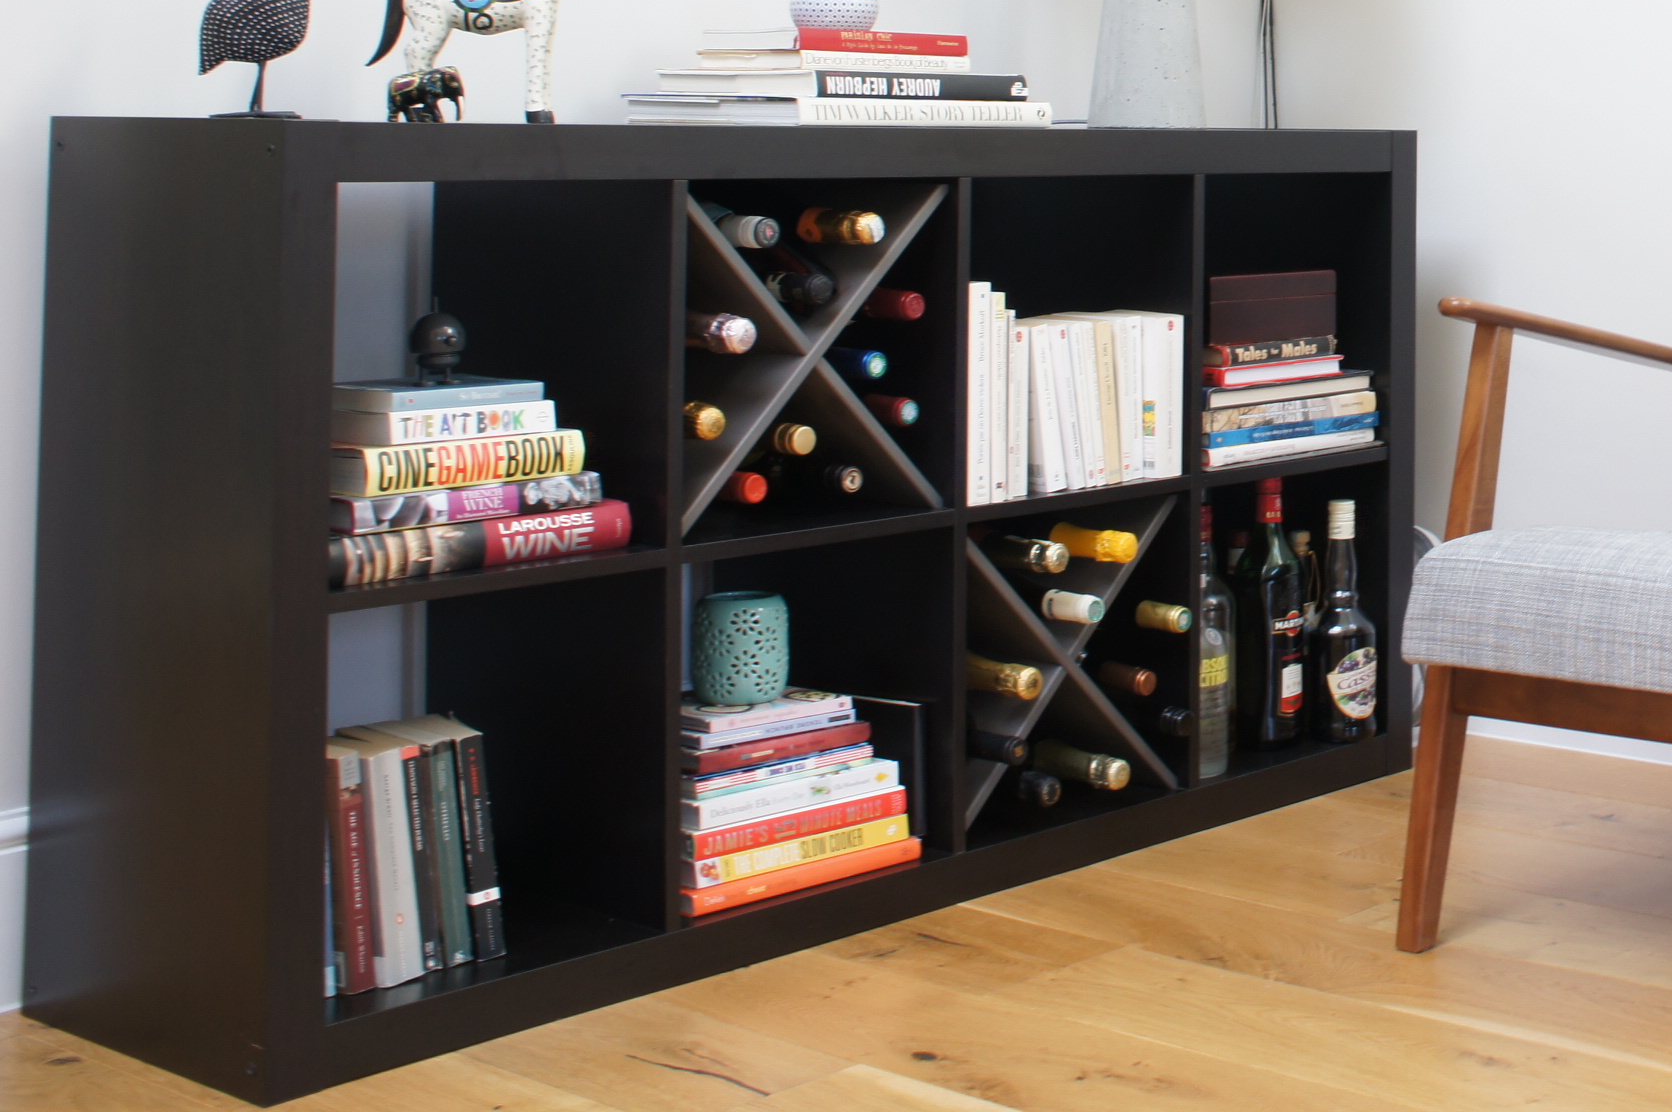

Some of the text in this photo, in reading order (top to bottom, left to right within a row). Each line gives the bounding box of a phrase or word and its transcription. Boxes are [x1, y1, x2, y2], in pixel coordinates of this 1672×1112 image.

[825, 75, 941, 97] AUDREY HEPBURN
[813, 105, 1024, 122] TIM WALKER STORY TELLER
[1234, 345, 1268, 363] Tales
[1281, 340, 1318, 358] Males
[400, 412, 435, 440] THE
[477, 409, 527, 434] BOOK
[378, 435, 566, 493] CINEGAMEBOOK
[461, 488, 504, 500] FRENCH
[462, 497, 504, 512] WINE
[498, 512, 596, 535] LAROUSSE
[502, 526, 595, 560] WINE
[704, 825, 769, 856] JAMIE'S
[799, 808, 843, 833] MINUTE
[846, 799, 882, 823] MEALS
[800, 837, 827, 860] SLOW
[829, 828, 863, 852] COOKER
